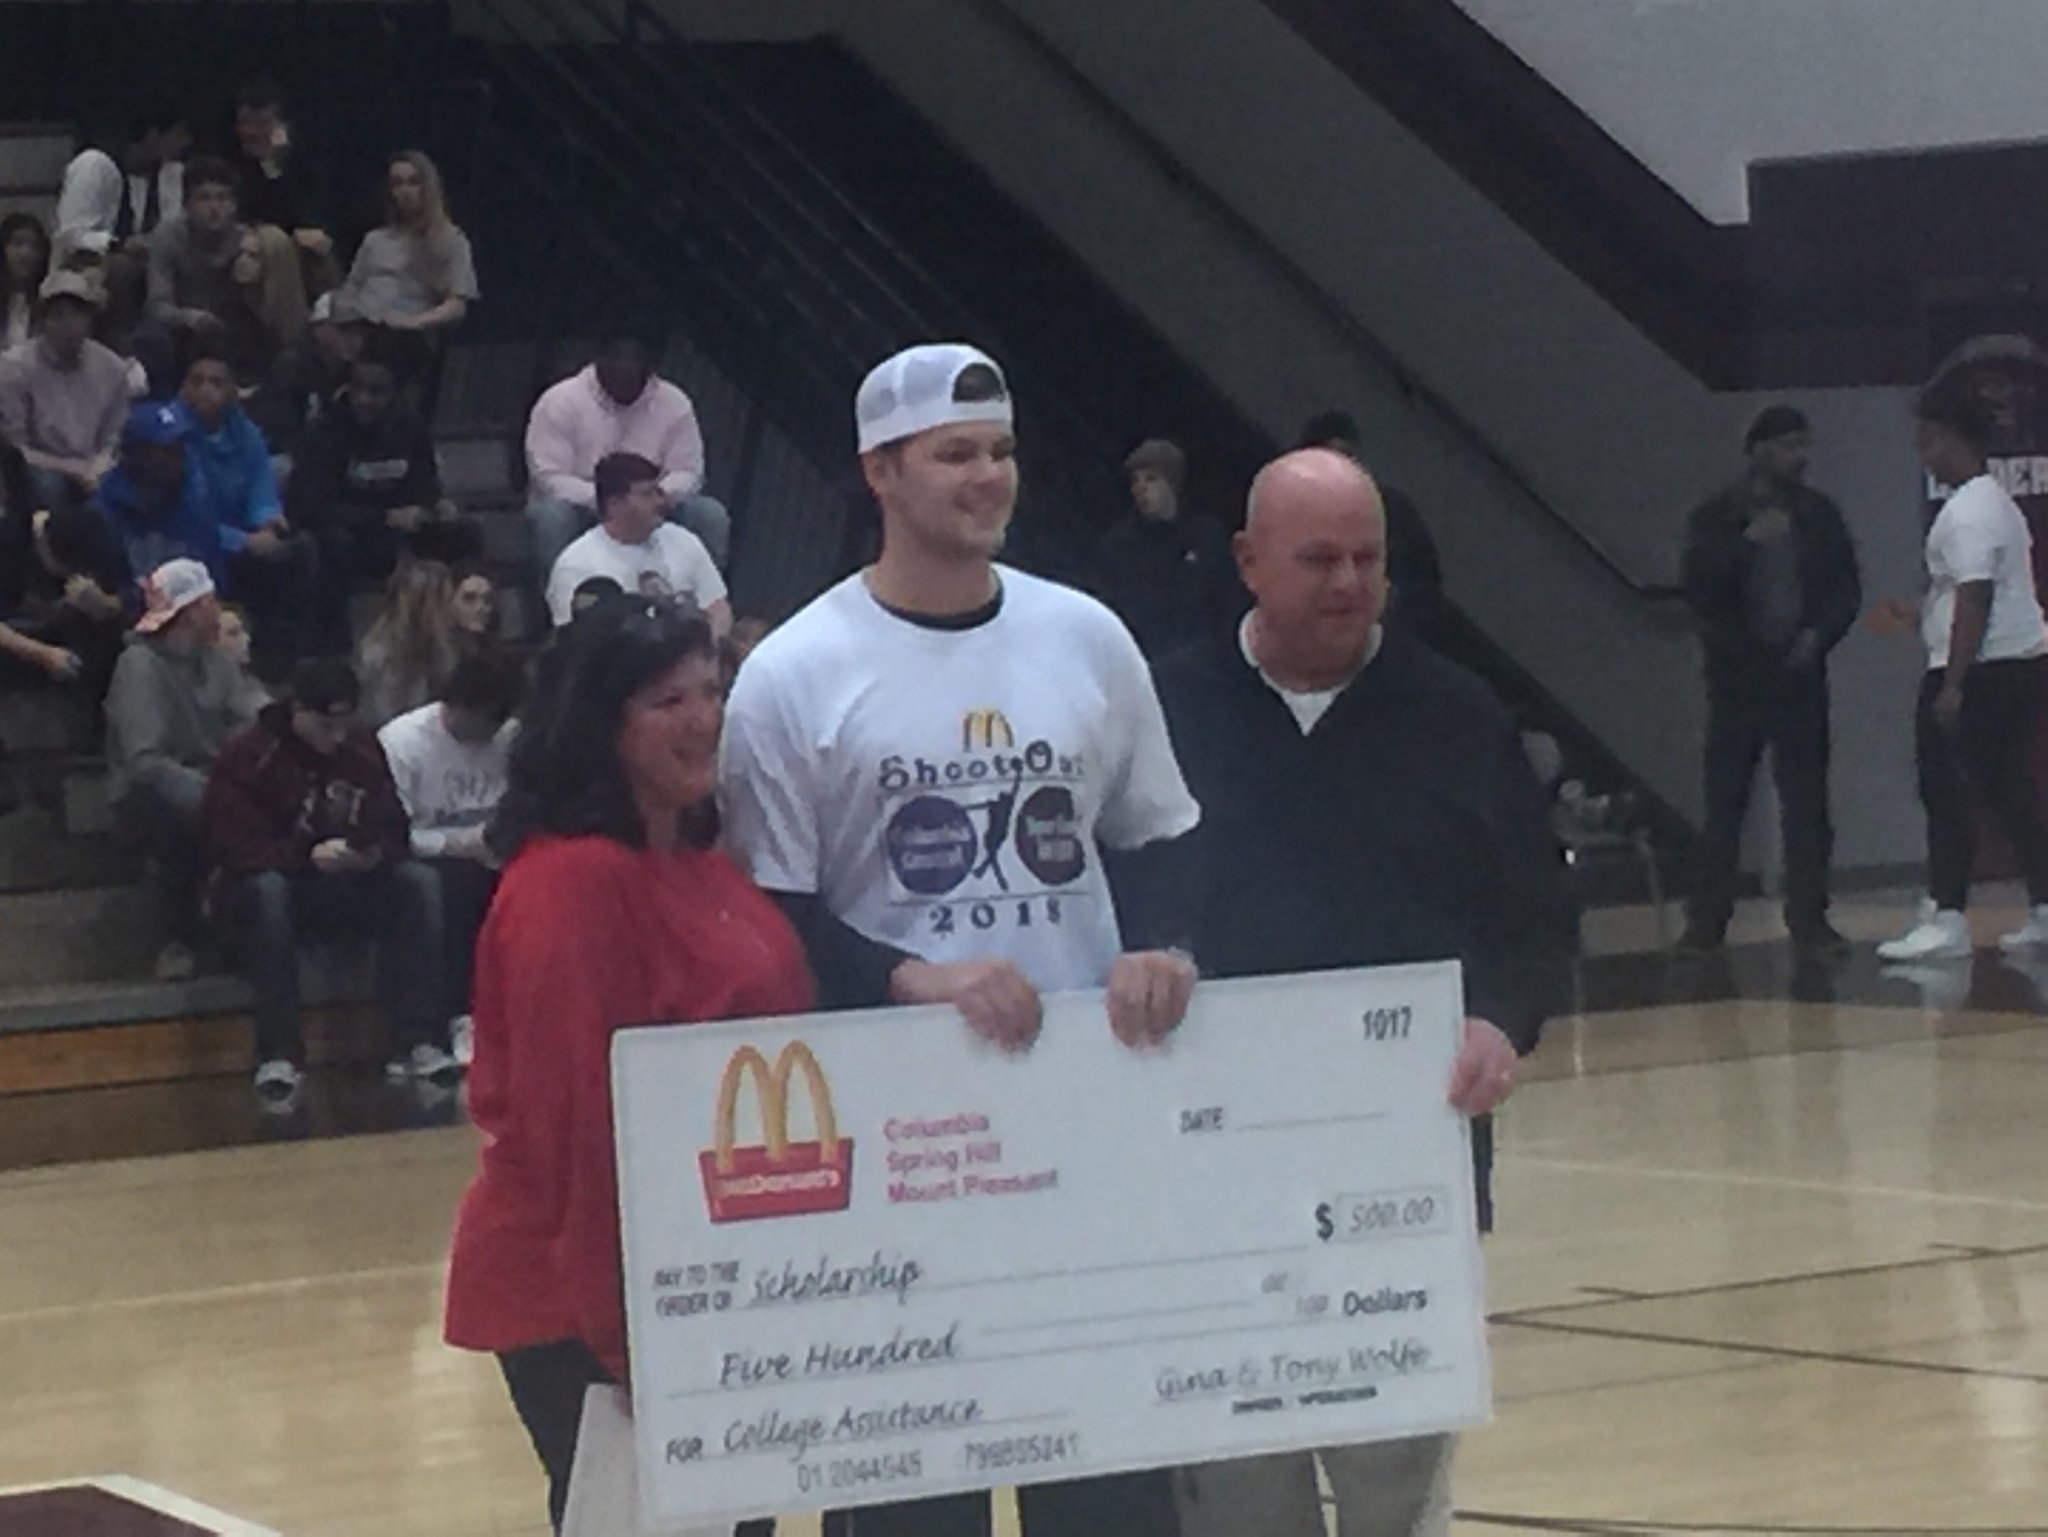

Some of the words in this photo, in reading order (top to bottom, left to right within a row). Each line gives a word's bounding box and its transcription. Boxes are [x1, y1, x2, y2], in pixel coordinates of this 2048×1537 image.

[1363, 1006, 1412, 1040] 1017
[1179, 1107, 1224, 1134] DATE
[886, 1149, 958, 1176] Spring
[887, 1180, 957, 1203] Mount
[1349, 1196, 1435, 1233] 500.00
[1343, 1288, 1427, 1316] Dollars
[719, 1350, 791, 1386] Five
[804, 1322, 958, 1375] Hundred
[1270, 1354, 1341, 1382] Tony
[665, 1437, 704, 1464] FOR
[723, 1408, 826, 1460] College
